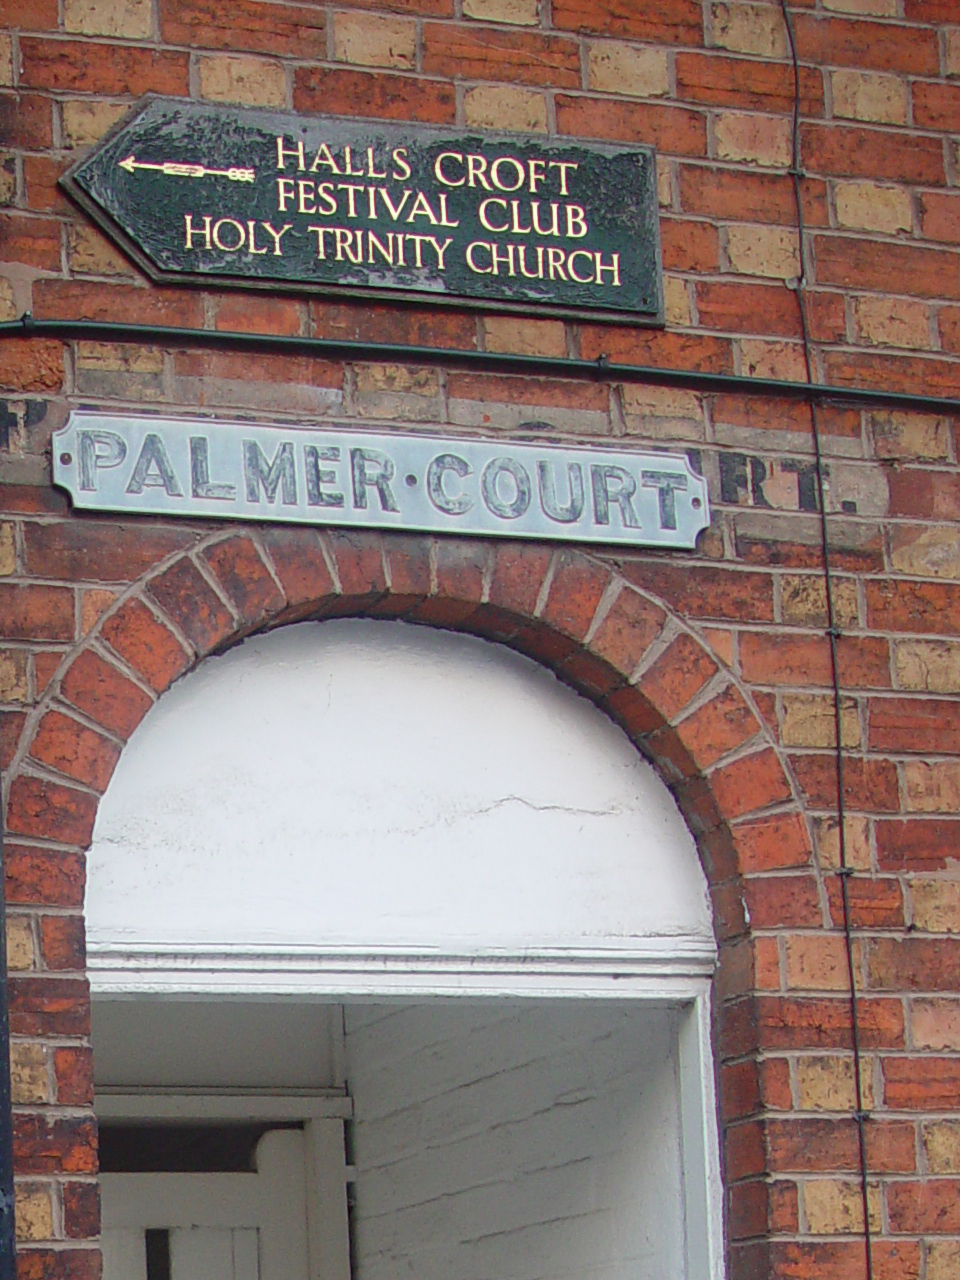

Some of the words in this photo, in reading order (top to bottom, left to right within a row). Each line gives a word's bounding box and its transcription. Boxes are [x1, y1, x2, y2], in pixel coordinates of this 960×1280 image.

[434, 152, 579, 196] CROFT
[276, 178, 460, 227] FESTIVAL
[478, 198, 589, 239] CLUB
[184, 215, 292, 256] HOLY
[307, 226, 453, 270] TRINITY
[466, 241, 622, 286] CHURCH
[75, 429, 401, 513] PALMER
[425, 451, 688, 531] COURT
